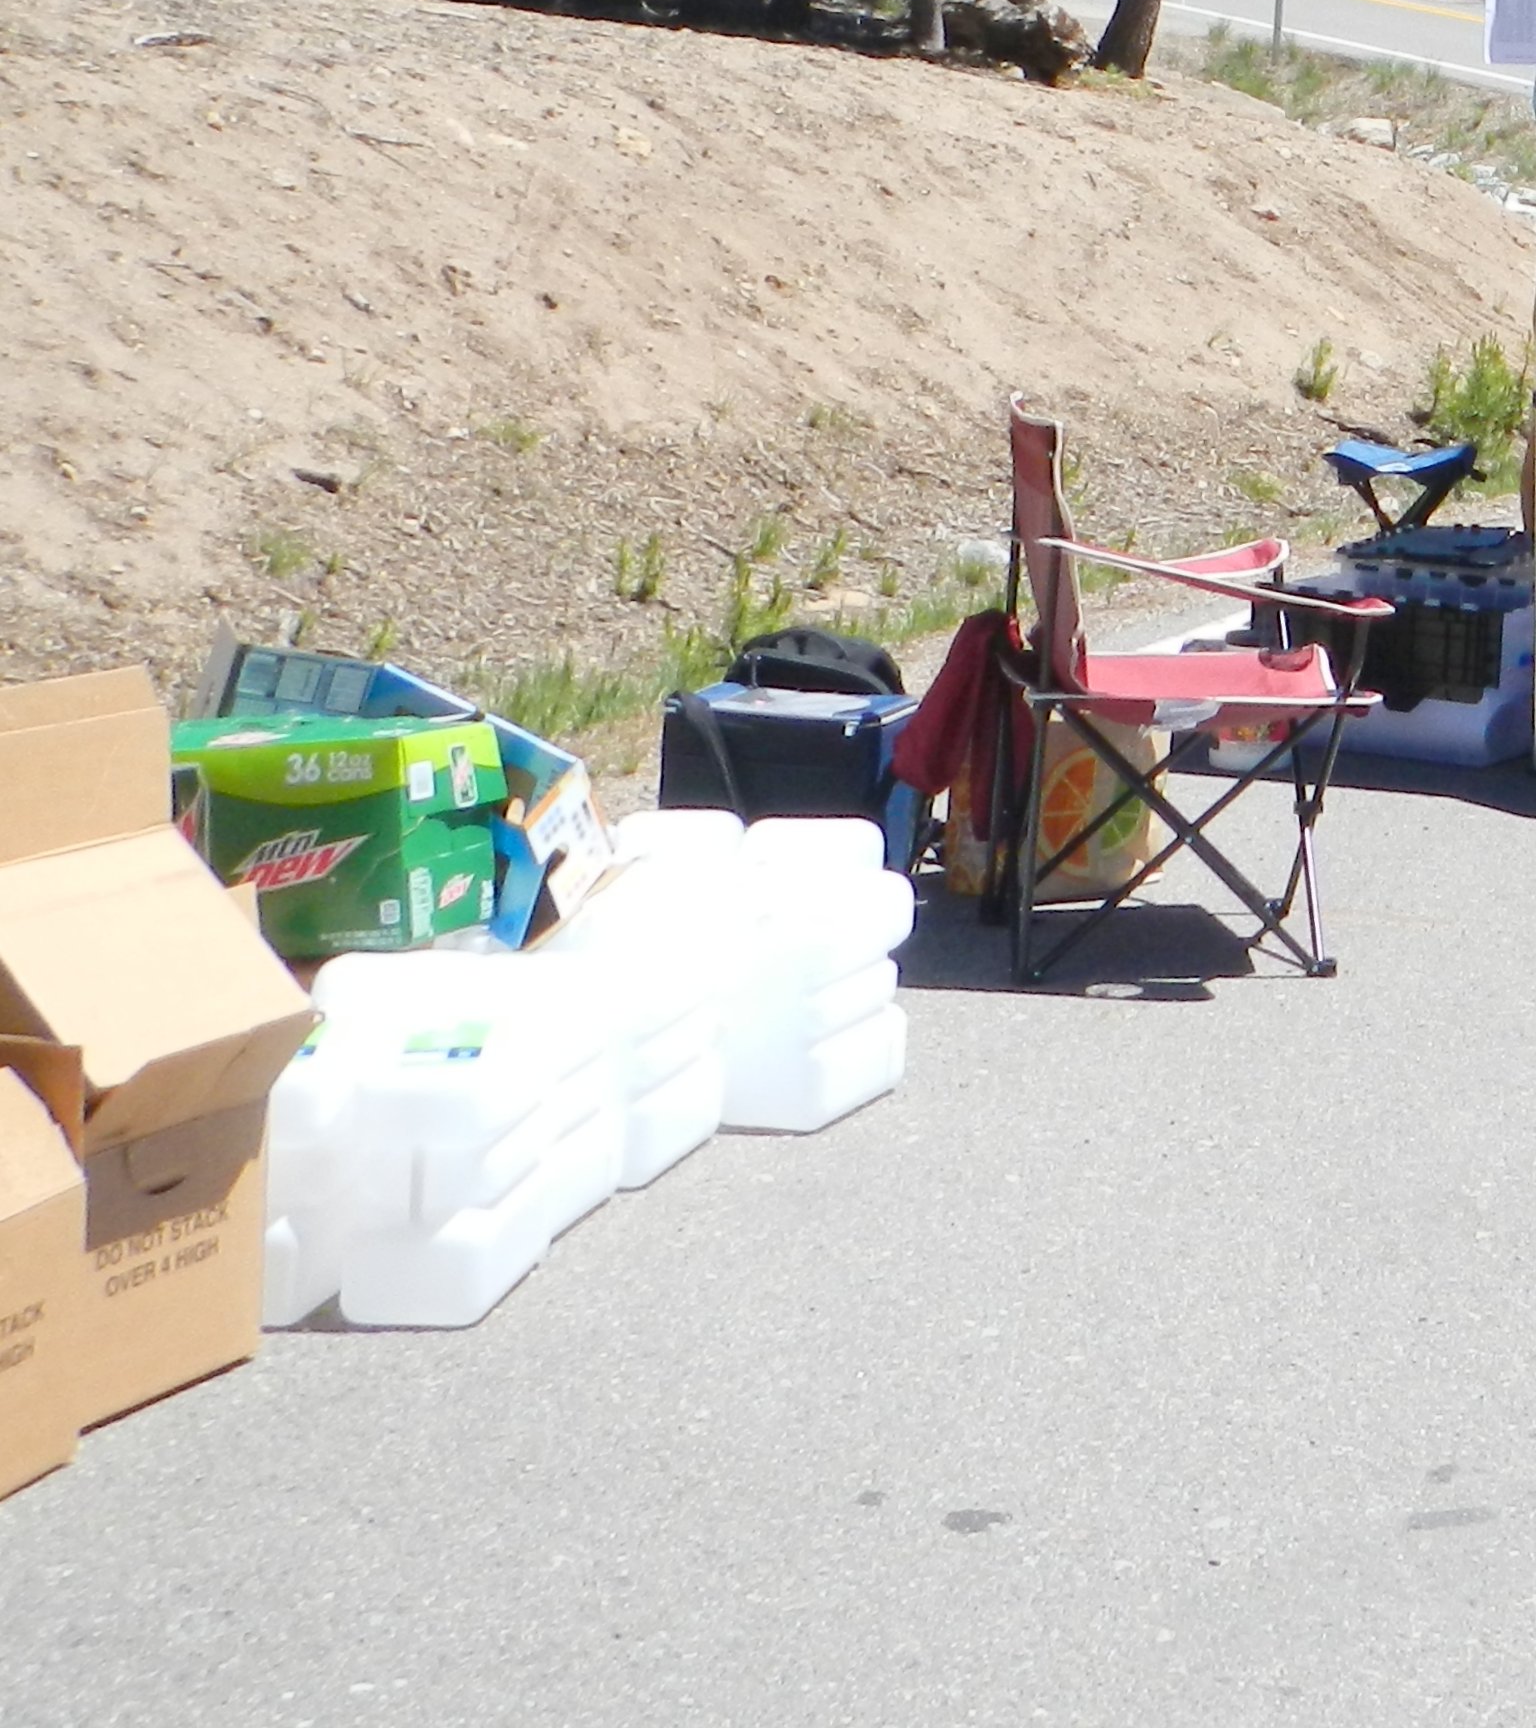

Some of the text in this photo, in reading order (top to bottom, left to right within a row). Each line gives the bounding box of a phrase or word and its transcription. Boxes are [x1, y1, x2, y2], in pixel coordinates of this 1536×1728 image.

[286, 752, 321, 784] 36
[96, 1201, 228, 1270] DO NOT STACK
[105, 1260, 157, 1296] OVER
[174, 1236, 220, 1269] HIGH
